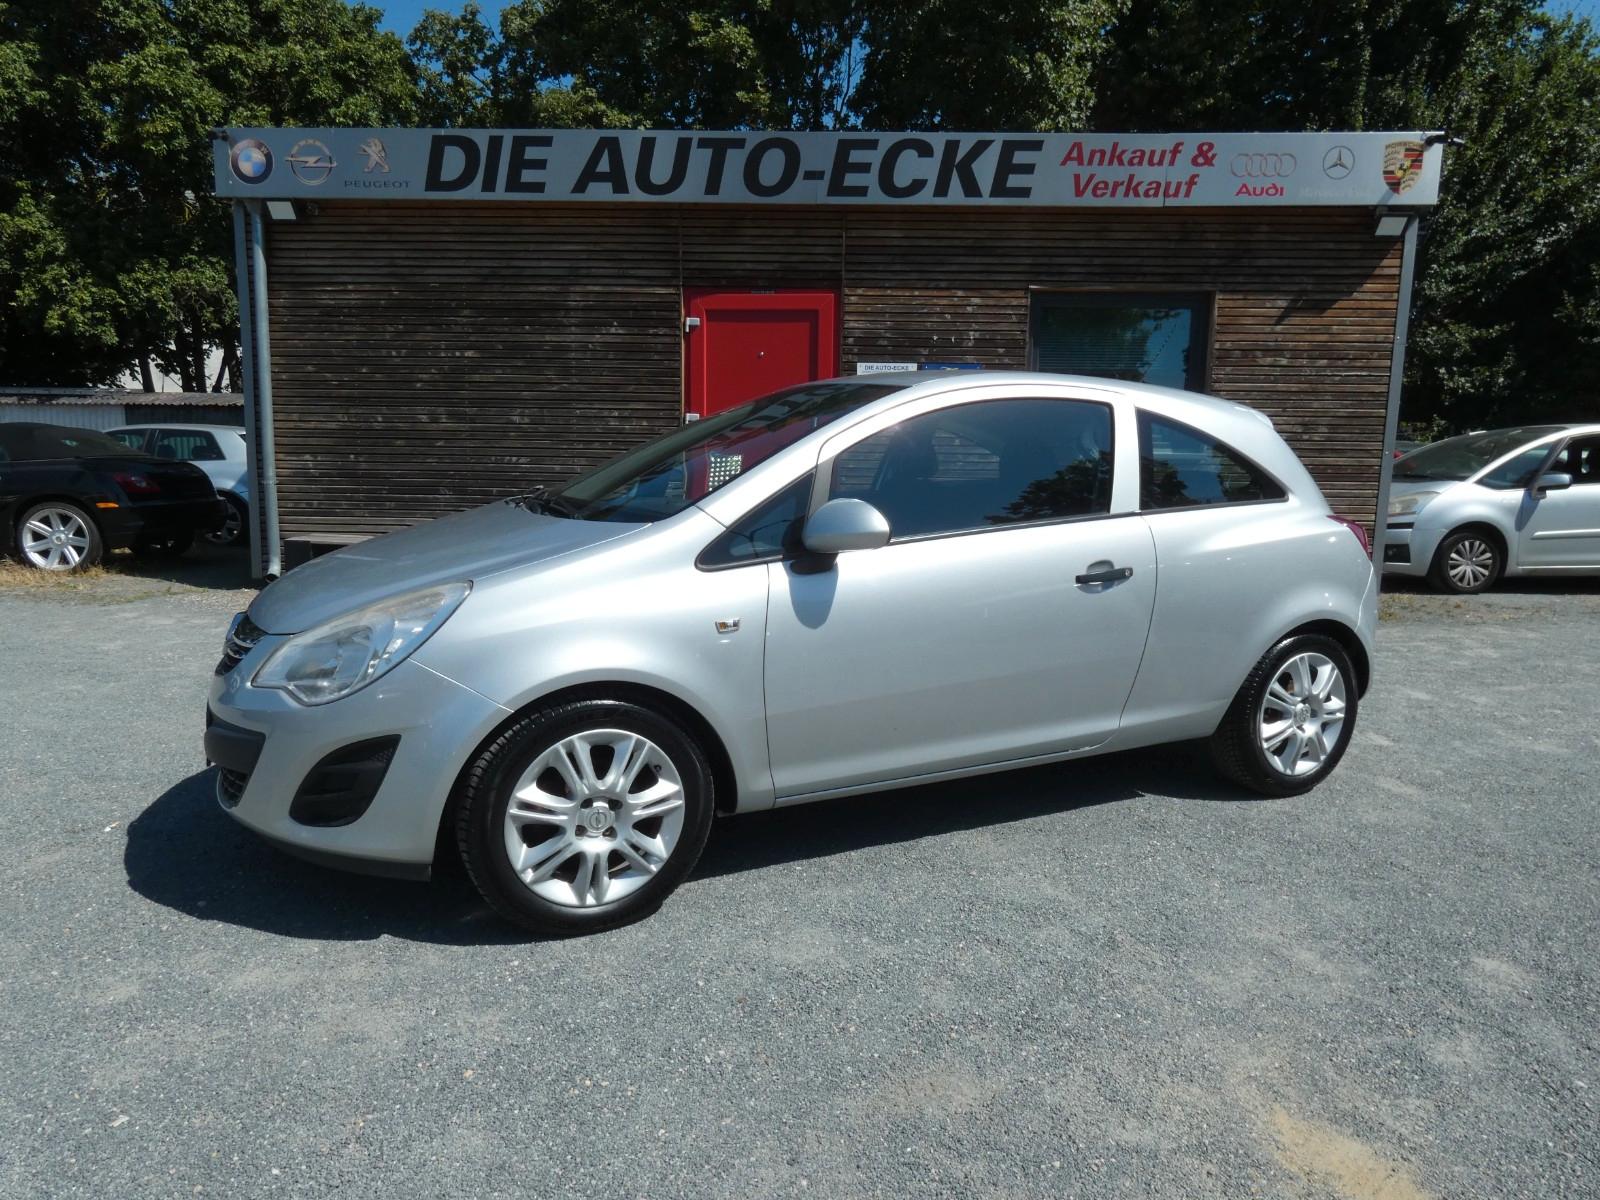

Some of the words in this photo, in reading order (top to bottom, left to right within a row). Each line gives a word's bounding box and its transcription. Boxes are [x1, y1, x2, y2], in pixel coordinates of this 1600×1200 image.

[424, 135, 554, 194] DIE
[570, 136, 1045, 198] AUTO-ECKE
[1060, 141, 1185, 167] Ankauf
[1191, 141, 1217, 167] &
[344, 180, 411, 189] PEUGEOT
[1072, 173, 1200, 198] Verkauf
[1235, 183, 1285, 197] Audi
